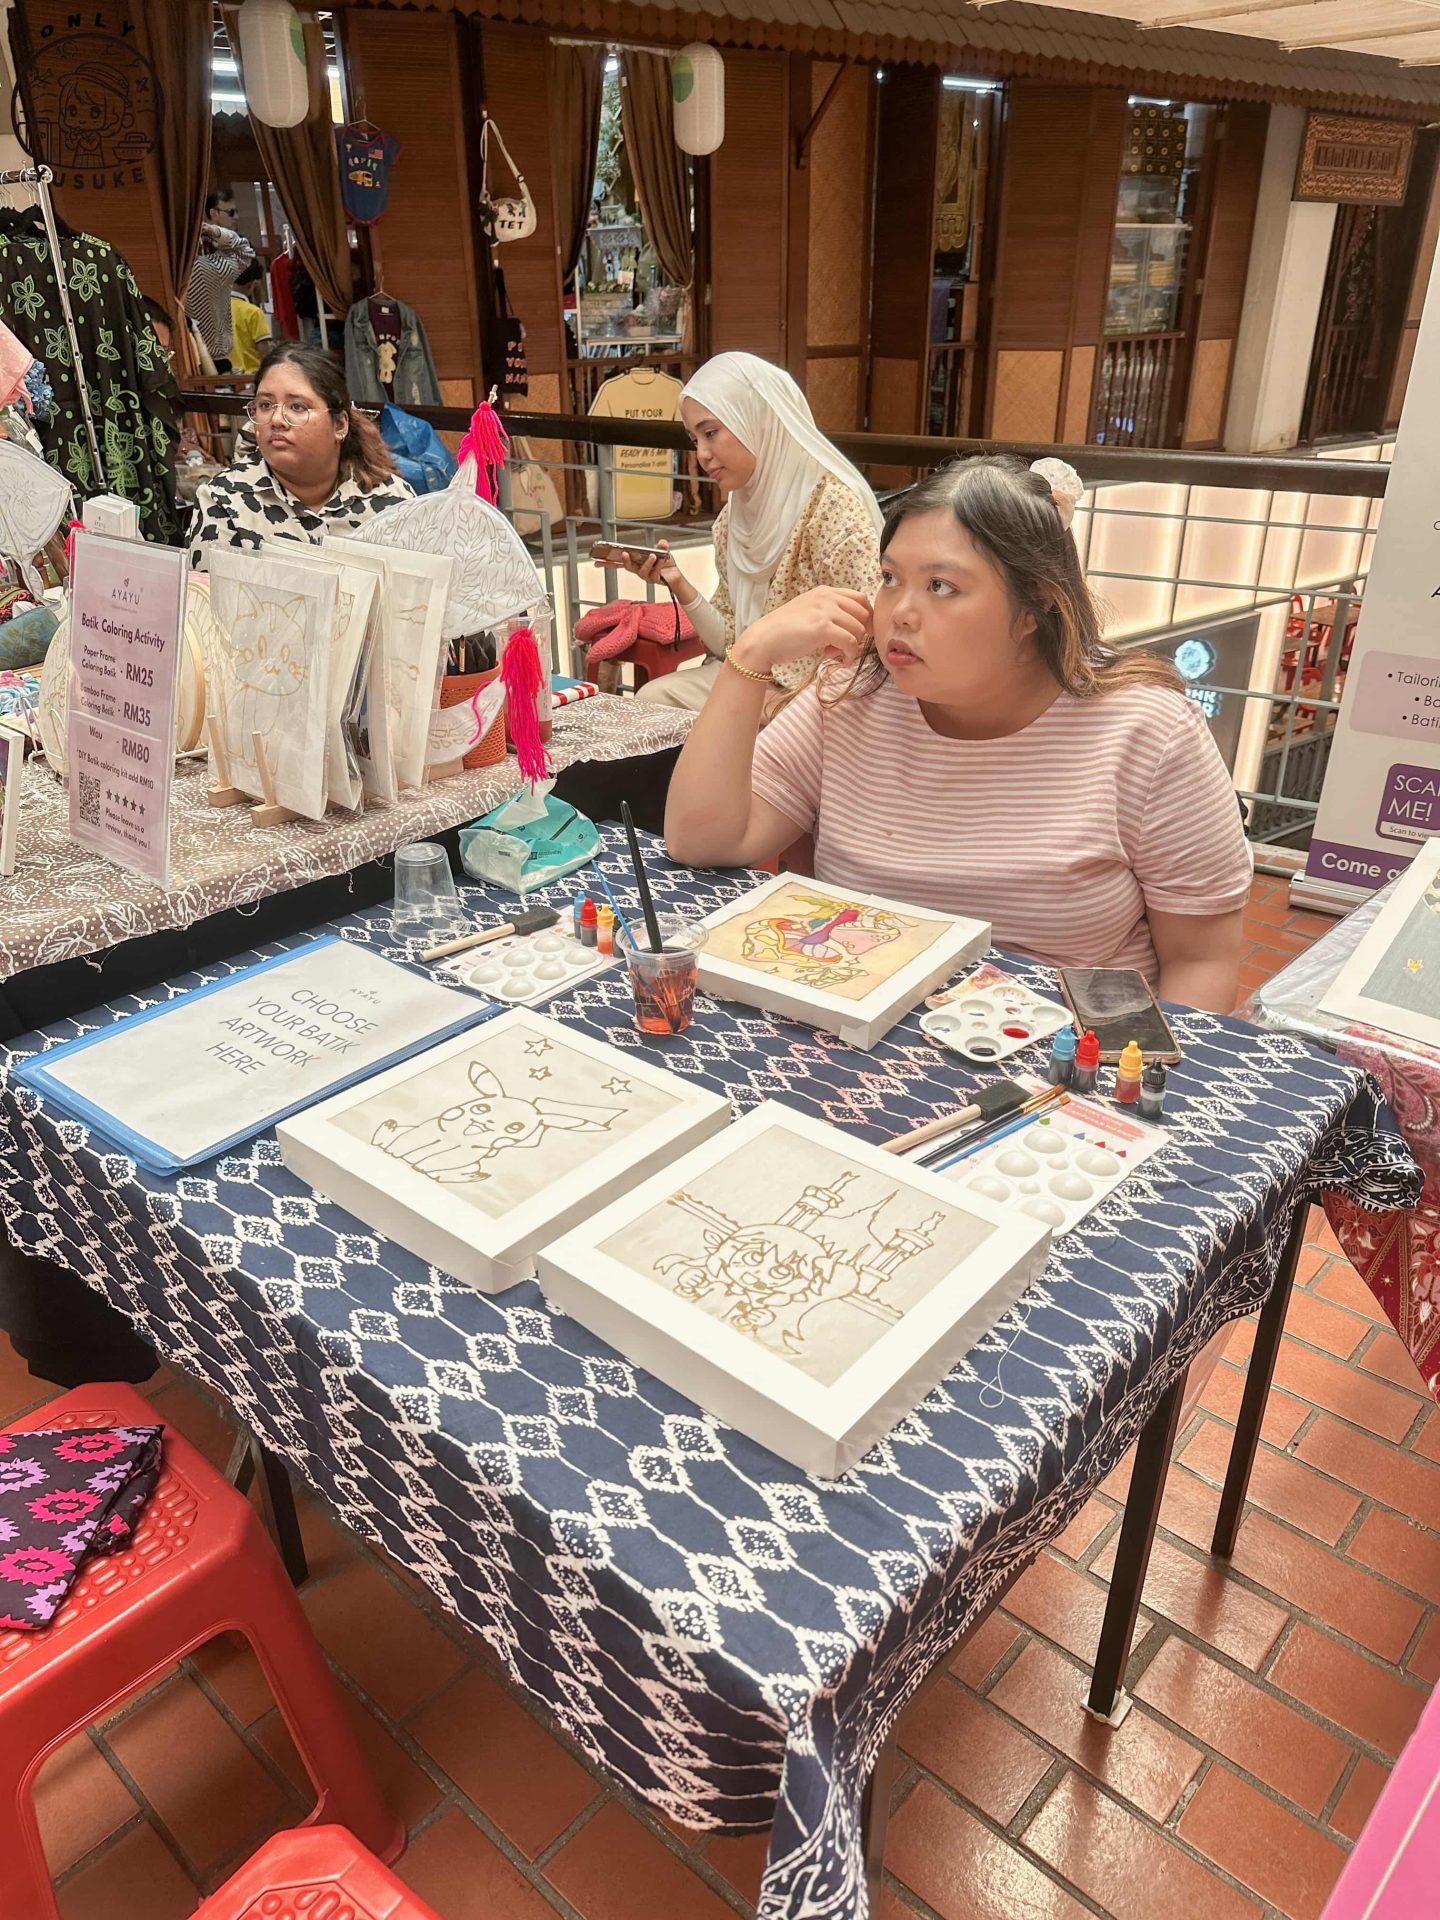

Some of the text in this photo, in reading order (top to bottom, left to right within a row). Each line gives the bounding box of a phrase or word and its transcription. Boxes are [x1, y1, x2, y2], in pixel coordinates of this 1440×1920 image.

[499, 220, 523, 230] TET
[625, 408, 663, 418] PUT YOUR
[112, 588, 140, 605] AYAYU
[81, 613, 166, 653] Batik Coloring Activity
[84, 645, 116, 663] Paper Frame
[81, 659, 103, 676] Coloring
[103, 665, 116, 678] Batik
[126, 663, 154, 688] RM25
[1397, 671, 1440, 688] Tailori
[100, 689, 116, 703] Frame
[80, 697, 101, 714] Coloring
[101, 704, 114, 717] Batik
[124, 702, 151, 727] RM35
[1411, 713, 1440, 729] Bati
[89, 725, 103, 740] Wau
[122, 738, 150, 764] RM80
[87, 753, 100, 767] Batik
[100, 760, 120, 778] coloring
[120, 767, 128, 778] kit
[128, 773, 139, 784] add
[139, 776, 154, 790] RM10
[1393, 774, 1440, 797] SCA
[105, 807, 120, 822] Please
[121, 815, 134, 829] leave
[134, 824, 140, 832] us
[1387, 797, 1433, 822] ME!
[123, 829, 138, 844] thank
[1389, 826, 1431, 839] Scan to vie
[1321, 852, 1382, 877] Come
[349, 987, 382, 1005] AYAYU
[248, 995, 361, 1054] YOUR BATIK
[290, 989, 379, 1035] CHOOSE
[217, 1017, 321, 1068] ARTWORK
[205, 1041, 266, 1075] HERE
